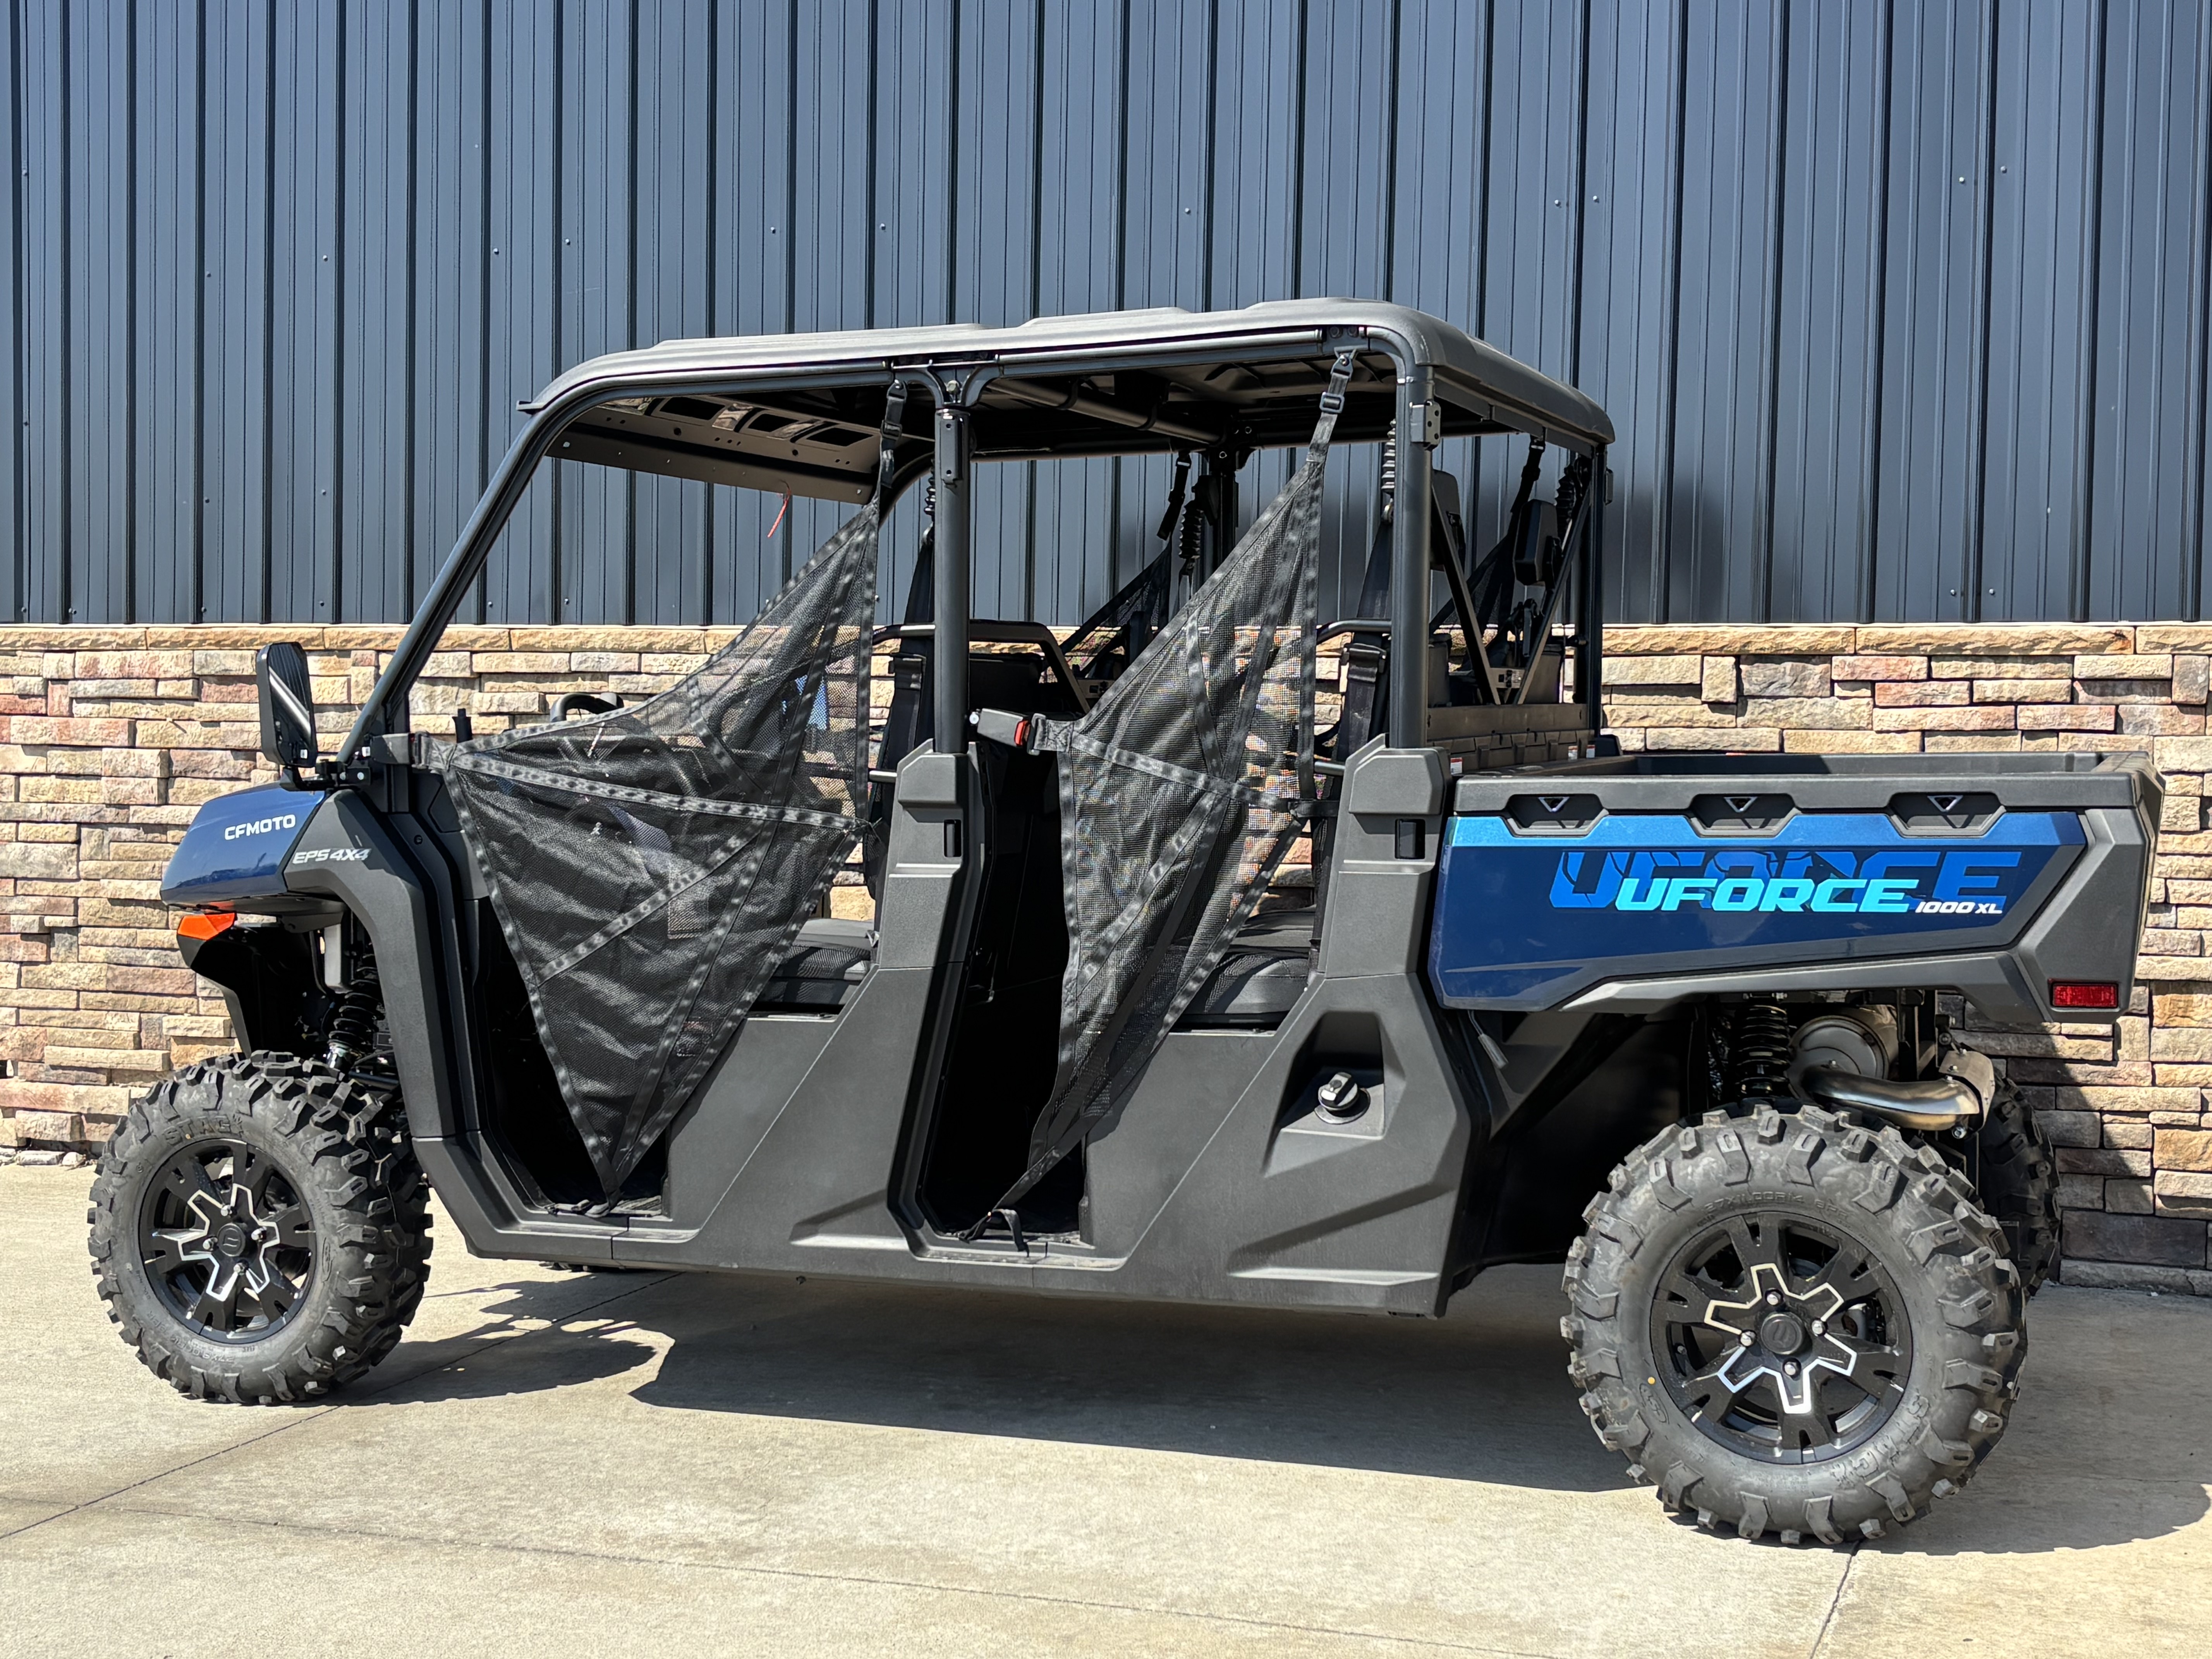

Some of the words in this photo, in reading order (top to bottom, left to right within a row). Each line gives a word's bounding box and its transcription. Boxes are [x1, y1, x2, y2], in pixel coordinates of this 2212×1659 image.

[224, 814, 296, 840] CFMOTO
[292, 848, 331, 864] EPS
[1615, 878, 1920, 912] UFORCE
[1915, 901, 1976, 914] 1000
[1975, 903, 2003, 914] XL
